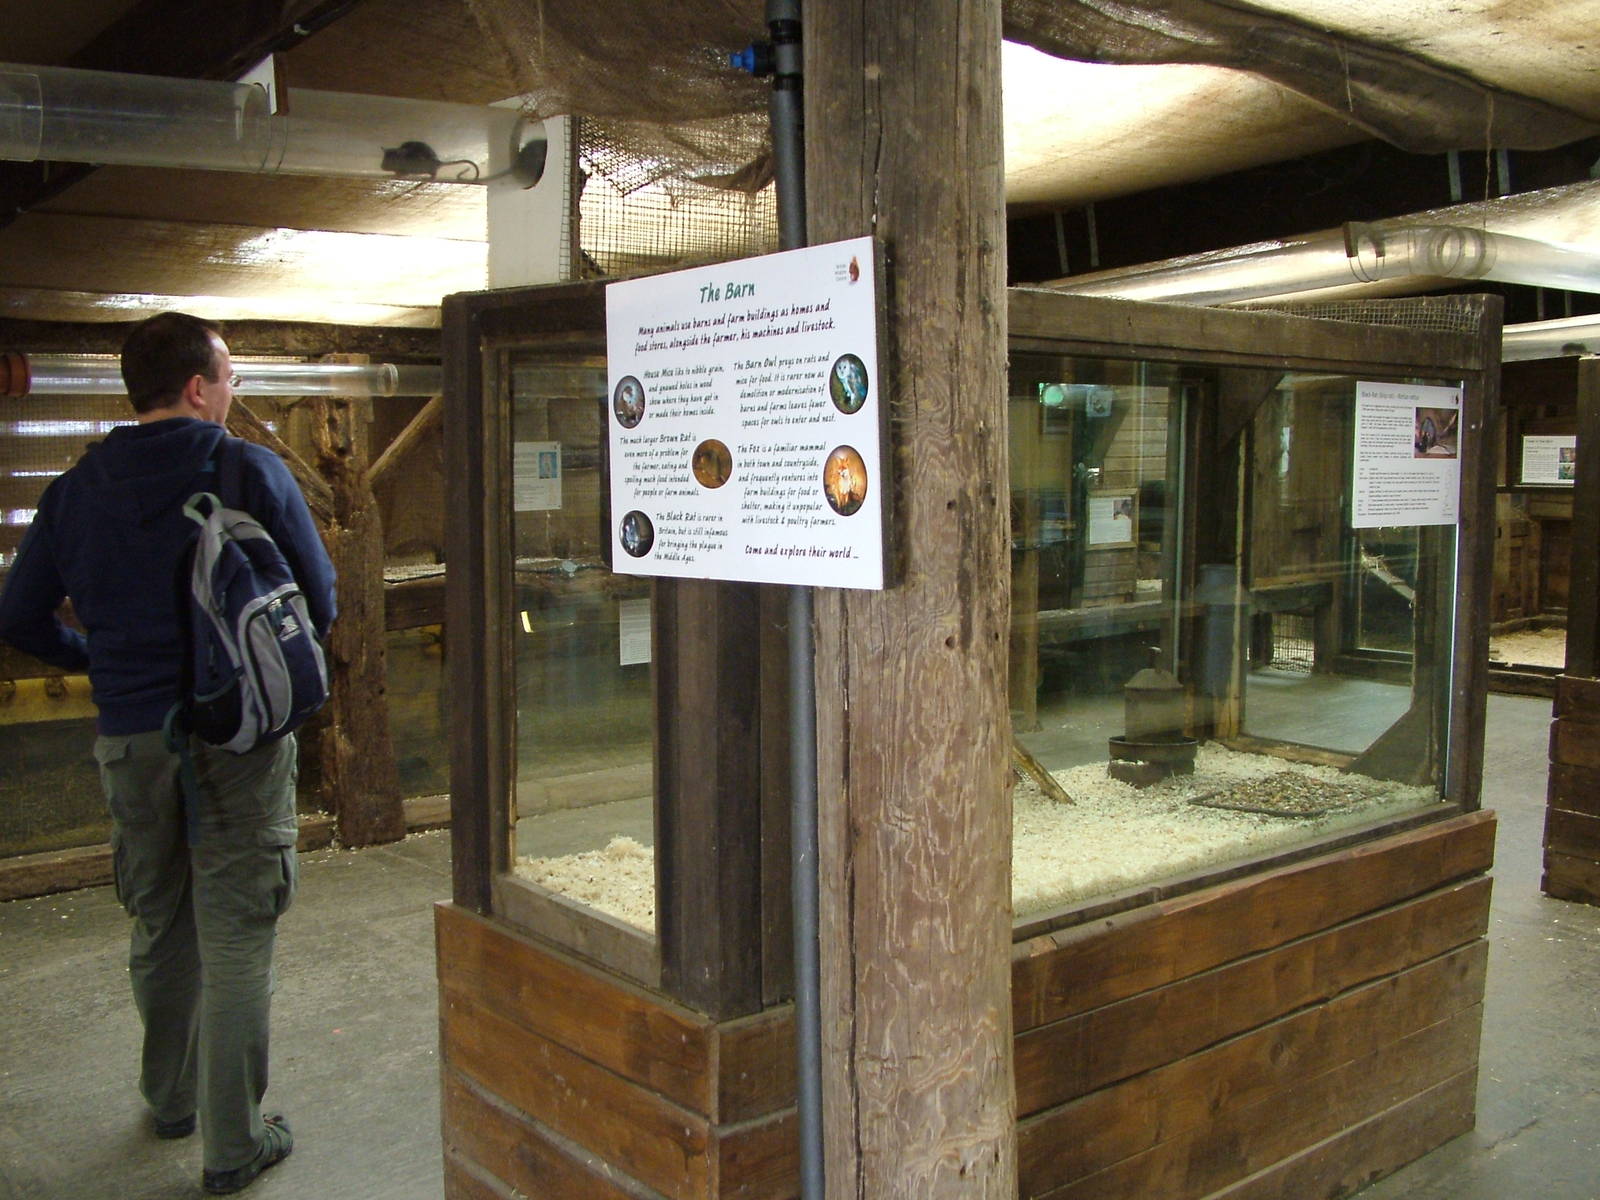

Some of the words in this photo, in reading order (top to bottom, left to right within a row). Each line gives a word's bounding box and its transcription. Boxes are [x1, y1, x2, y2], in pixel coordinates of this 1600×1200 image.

[700, 282, 720, 303] The
[725, 282, 755, 301] Barn
[638, 326, 654, 337] Many
[656, 320, 679, 333] animals
[681, 322, 691, 330] use
[693, 317, 710, 329] barns
[713, 313, 725, 325] and
[727, 313, 745, 327] farm
[747, 308, 778, 322] buildings
[780, 308, 788, 316] as
[791, 304, 813, 315] homes
[815, 298, 830, 312] and
[635, 341, 647, 356] food
[669, 335, 698, 350] alongside
[701, 334, 710, 344] the
[741, 329, 750, 340] his
[752, 326, 783, 338] machines
[786, 321, 800, 334] and
[734, 362, 743, 371] The
[745, 360, 762, 369] Barn
[764, 355, 777, 367] Owl
[779, 358, 794, 369] preys
[804, 354, 816, 364] rats
[818, 352, 830, 362] and
[644, 370, 659, 379] House
[661, 368, 673, 378] Mice
[675, 368, 683, 376] like
[692, 365, 706, 375] nibble
[736, 376, 747, 385] mice
[749, 374, 758, 387] for
[782, 372, 785, 381] is
[787, 372, 803, 380] rarer
[649, 384, 658, 392] and
[659, 382, 678, 394] gnawed
[680, 381, 692, 390] holes
[693, 380, 698, 388] in
[700, 379, 712, 387] wood
[740, 388, 767, 398] demolition
[777, 385, 816, 396] modernisation
[819, 384, 825, 395] of
[649, 397, 661, 405] show
[663, 395, 677, 404] where
[678, 394, 688, 405] they
[690, 394, 702, 402] have
[704, 392, 712, 404] got
[656, 409, 668, 418] made
[669, 408, 681, 417] their
[683, 408, 698, 416] homes
[740, 404, 755, 413] barns
[757, 402, 767, 411] and
[769, 400, 786, 414] farms
[788, 400, 807, 410] leaves
[809, 399, 826, 411] fewer
[742, 419, 759, 429] spaces
[761, 416, 770, 428] for
[771, 416, 783, 425] owls
[785, 416, 790, 424] to
[792, 414, 807, 424] enter
[809, 413, 820, 423] and
[630, 436, 641, 444] much
[643, 435, 658, 446] larger
[660, 434, 678, 442] Brown
[680, 432, 691, 442] Rat
[649, 449, 654, 458] of
[660, 449, 679, 458] problem
[738, 445, 747, 453] The
[749, 444, 760, 453] Fox
[773, 443, 797, 455] familiar
[800, 442, 826, 450] mammal
[662, 462, 677, 472] eating
[679, 461, 687, 469] and
[737, 460, 742, 468] in
[744, 460, 755, 468] both
[772, 458, 782, 467] and
[625, 476, 641, 486] spoiling
[657, 475, 667, 484] food
[738, 473, 748, 481] and
[750, 474, 779, 484] frequently
[634, 488, 642, 498] for
[643, 488, 657, 498] people
[665, 488, 677, 498] farm
[744, 488, 758, 498] farm
[760, 488, 785, 499] buildings
[788, 487, 796, 499] for
[798, 487, 810, 499] food
[764, 502, 785, 513] making
[787, 502, 791, 510] it
[793, 502, 822, 513] unpopular
[666, 511, 682, 521] Black
[685, 512, 697, 521] Rat
[742, 515, 753, 523] with
[755, 515, 778, 524] livestock
[787, 517, 808, 528] poultry
[678, 527, 686, 535] but
[704, 528, 728, 538] infamous
[668, 539, 688, 550] bringing
[699, 541, 716, 552] plague
[745, 545, 762, 554] Come
[764, 544, 778, 554] and
[780, 545, 806, 559] explore
[809, 545, 826, 557] their
[829, 546, 851, 558] world
